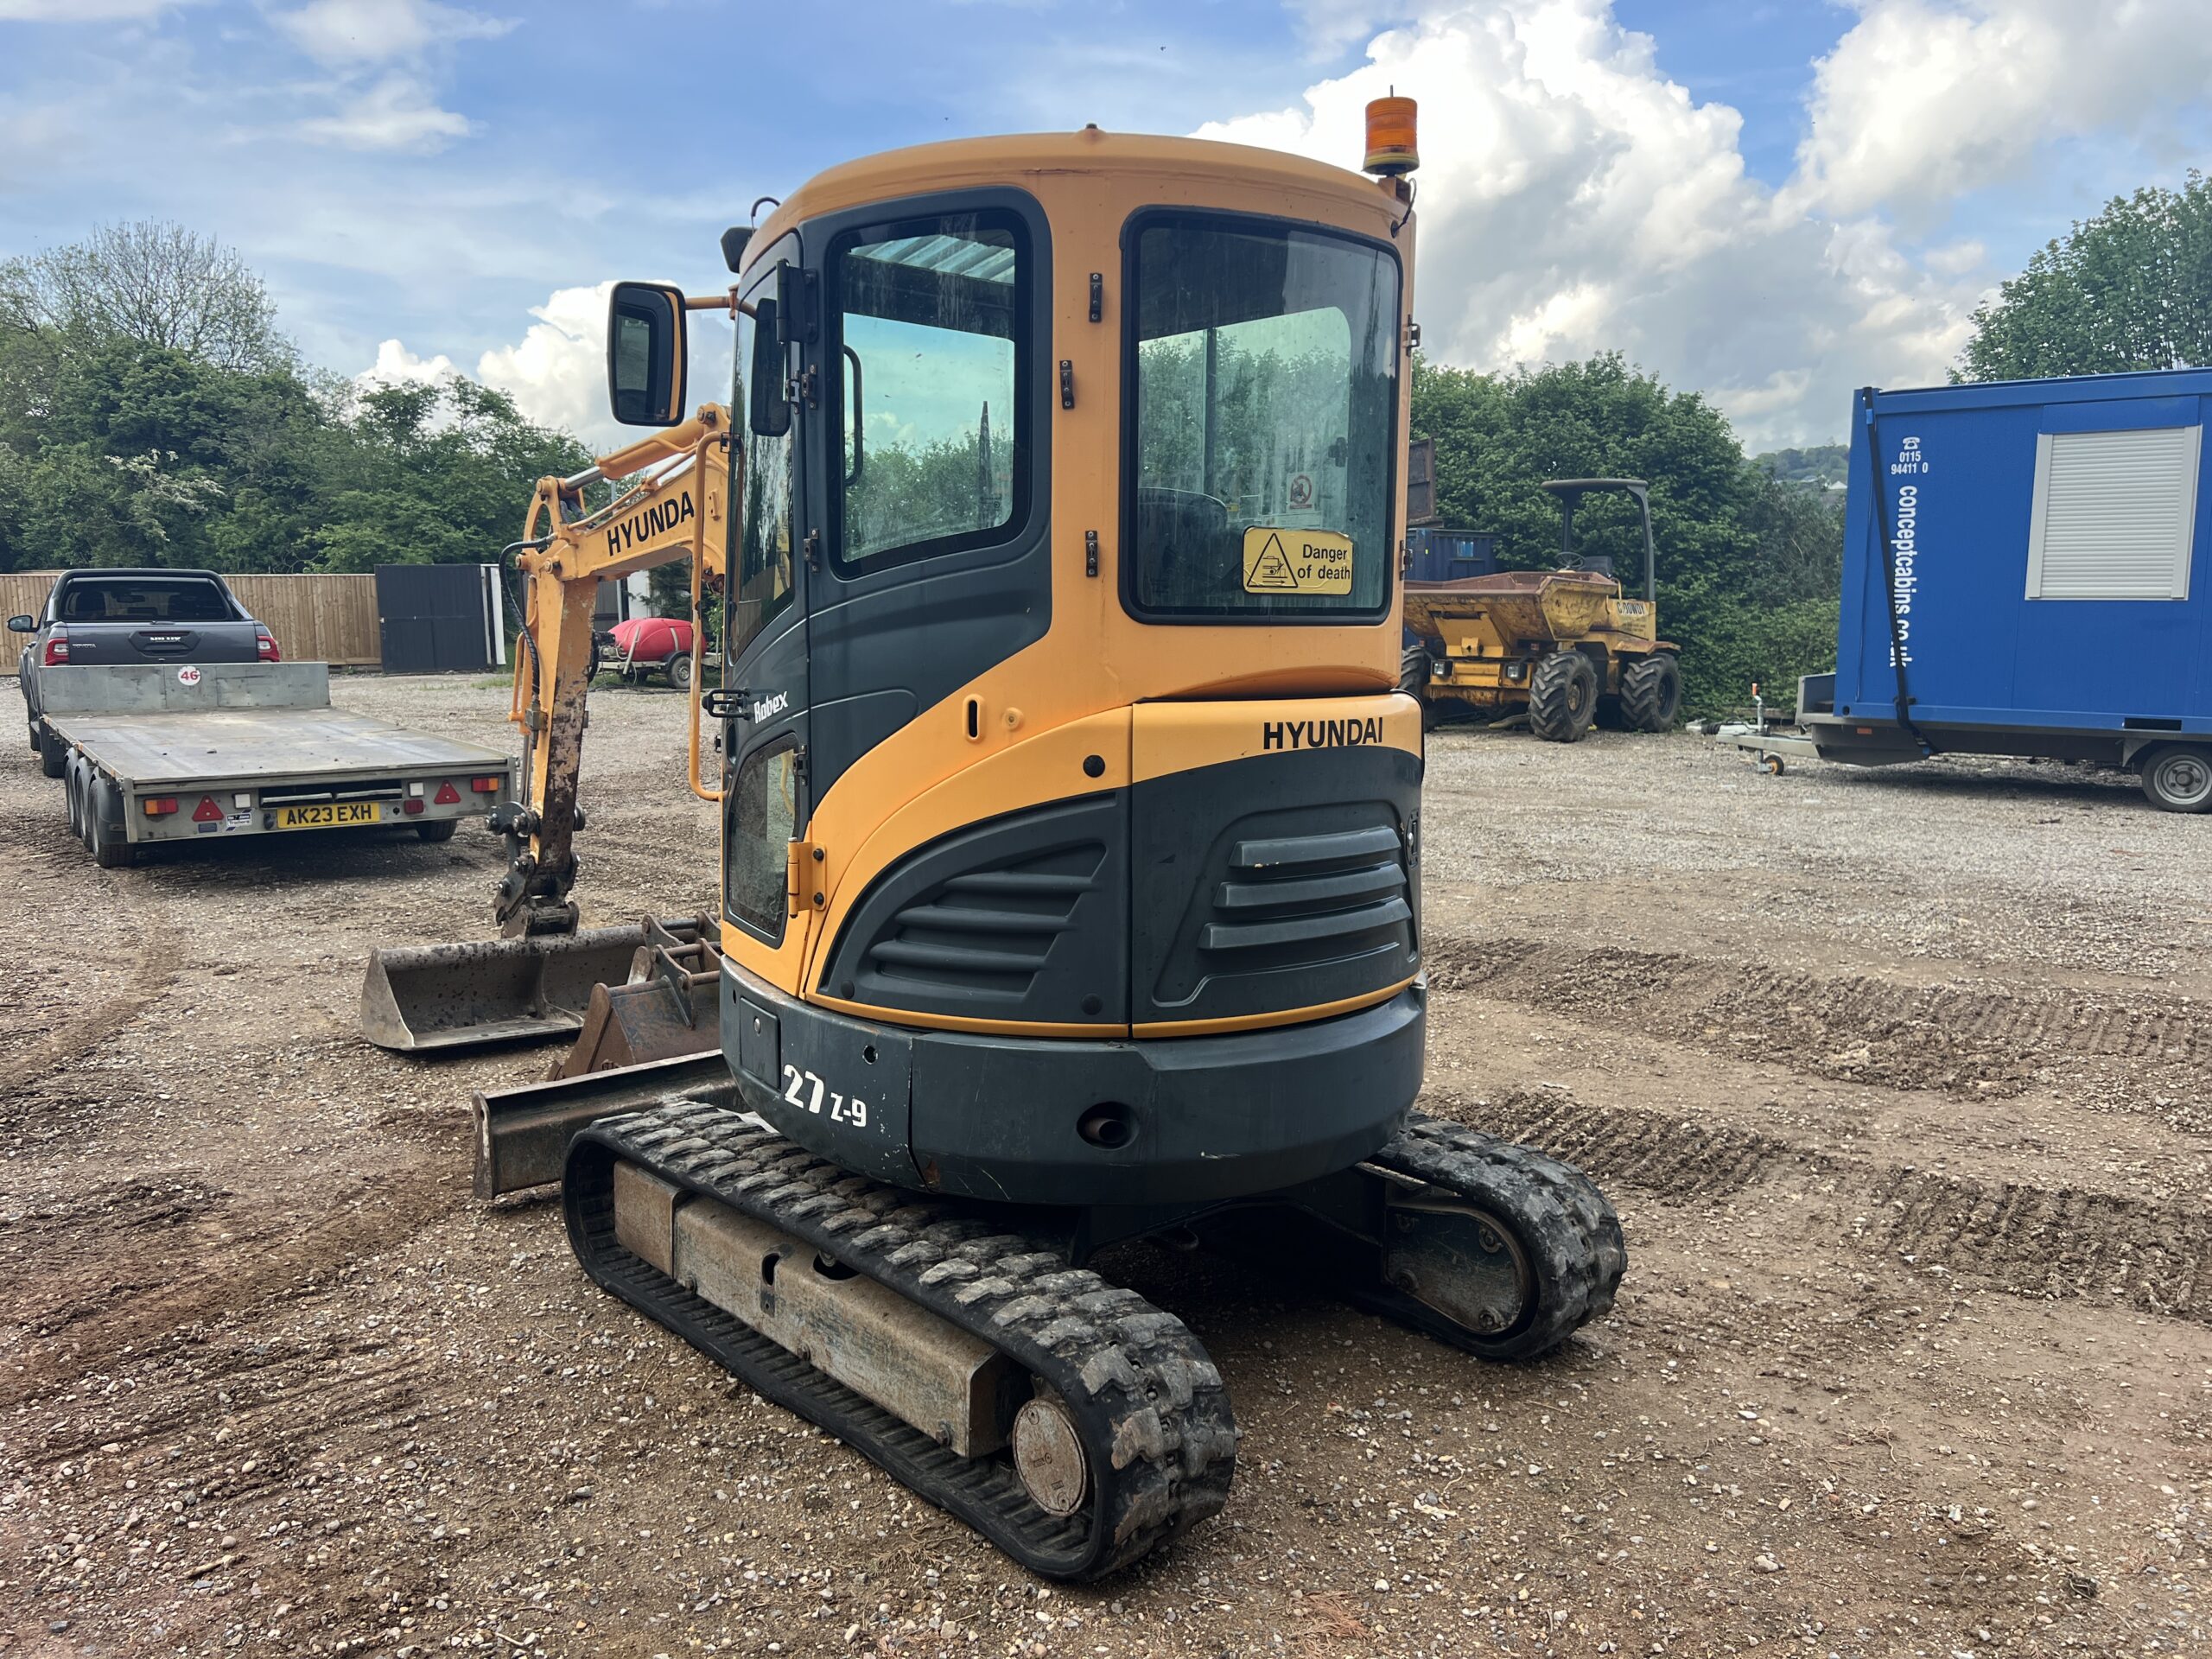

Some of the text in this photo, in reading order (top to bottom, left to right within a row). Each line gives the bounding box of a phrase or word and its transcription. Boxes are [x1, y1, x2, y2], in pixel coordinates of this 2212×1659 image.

[1899, 451, 1921, 462] 0115
[1891, 462, 1916, 474] 94411
[607, 491, 694, 556] HYUNDA
[1302, 544, 1347, 563] Danger
[1297, 564, 1351, 580] of death
[181, 671, 199, 681] 46
[753, 690, 788, 724] Robex
[1263, 716, 1382, 750] HYUNDAI
[286, 804, 372, 825] AK23 EXH
[783, 1064, 867, 1128] 27 Z-9
